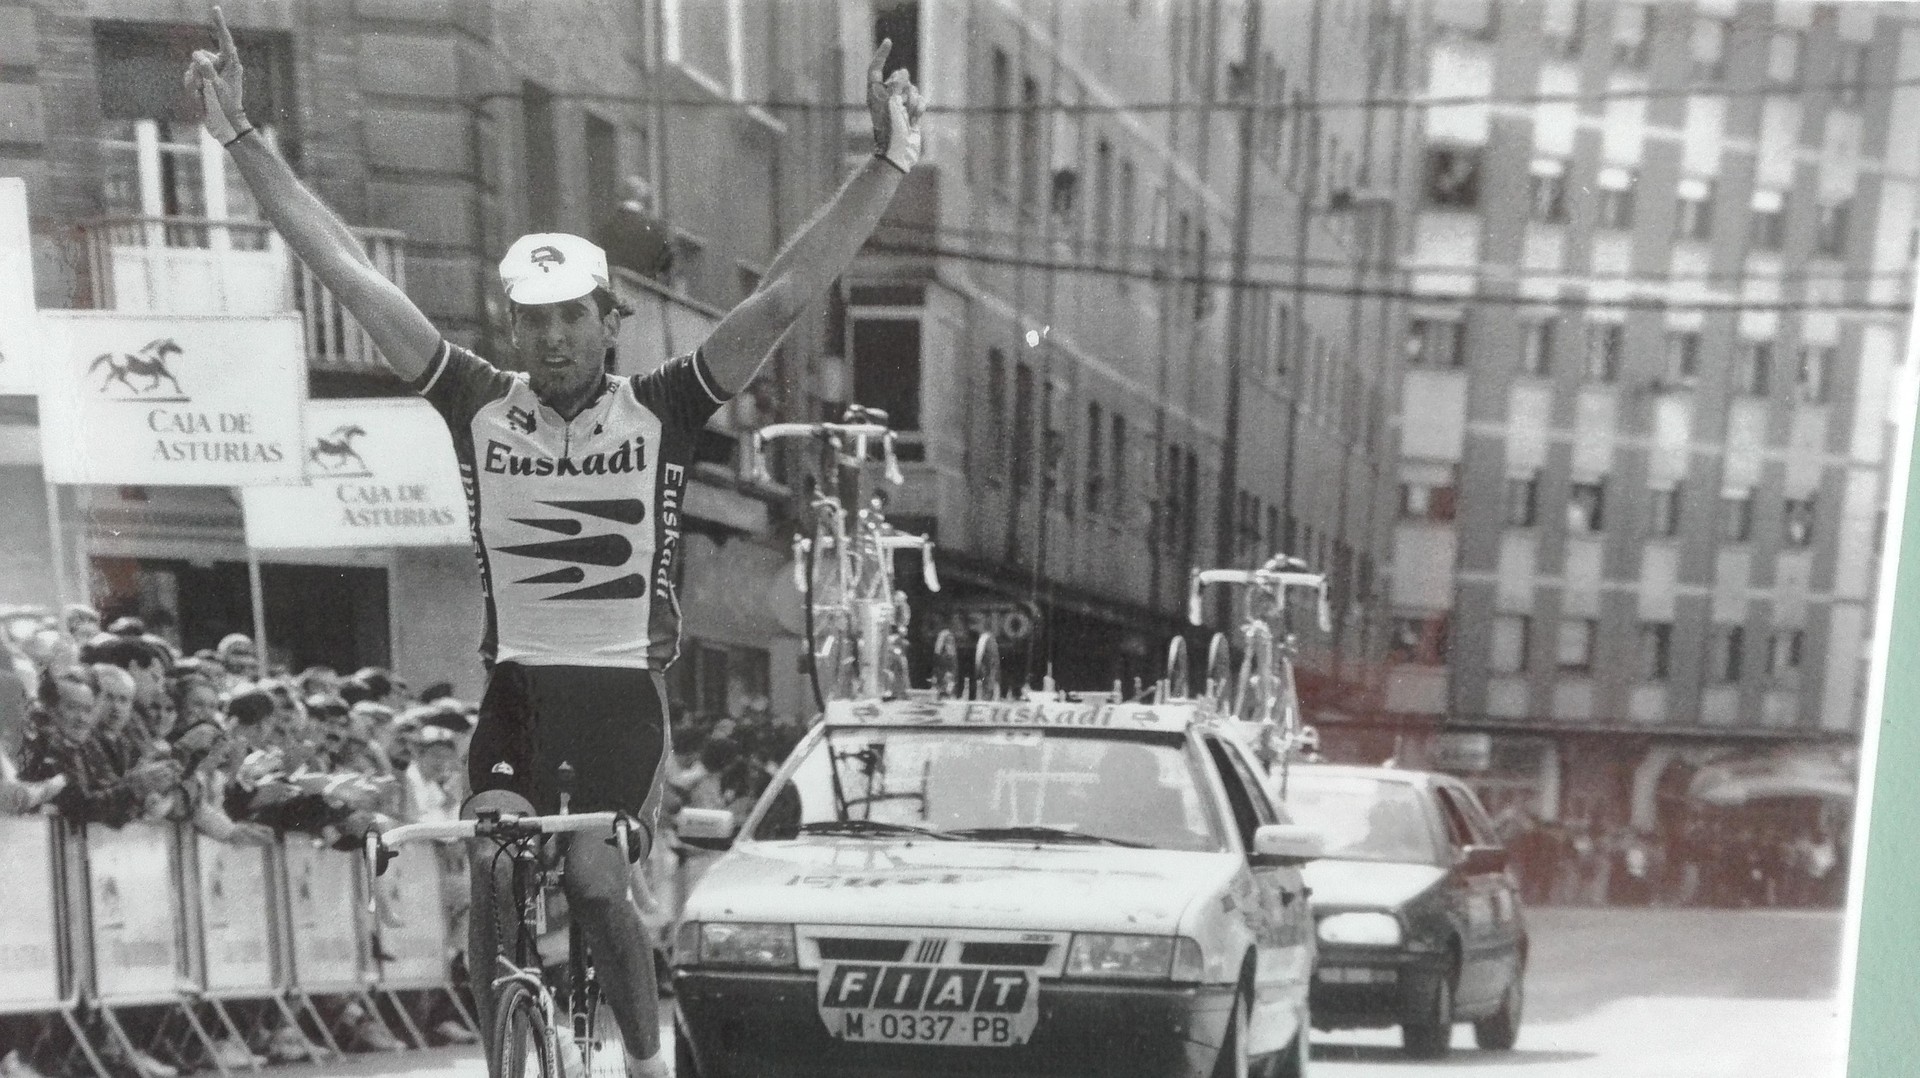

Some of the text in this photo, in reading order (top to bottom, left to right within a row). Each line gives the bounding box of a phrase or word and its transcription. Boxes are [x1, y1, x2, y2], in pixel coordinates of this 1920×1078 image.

[147, 409, 254, 434] CAJA DE
[153, 439, 284, 463] ASTURIAS
[484, 436, 648, 476] Euskadi
[336, 483, 430, 504] CAJA DE
[341, 507, 455, 527] ASTURIAS
[656, 462, 684, 600] Euskadi
[964, 703, 1114, 726] Euskadi
[837, 971, 1024, 1006] FIAT
